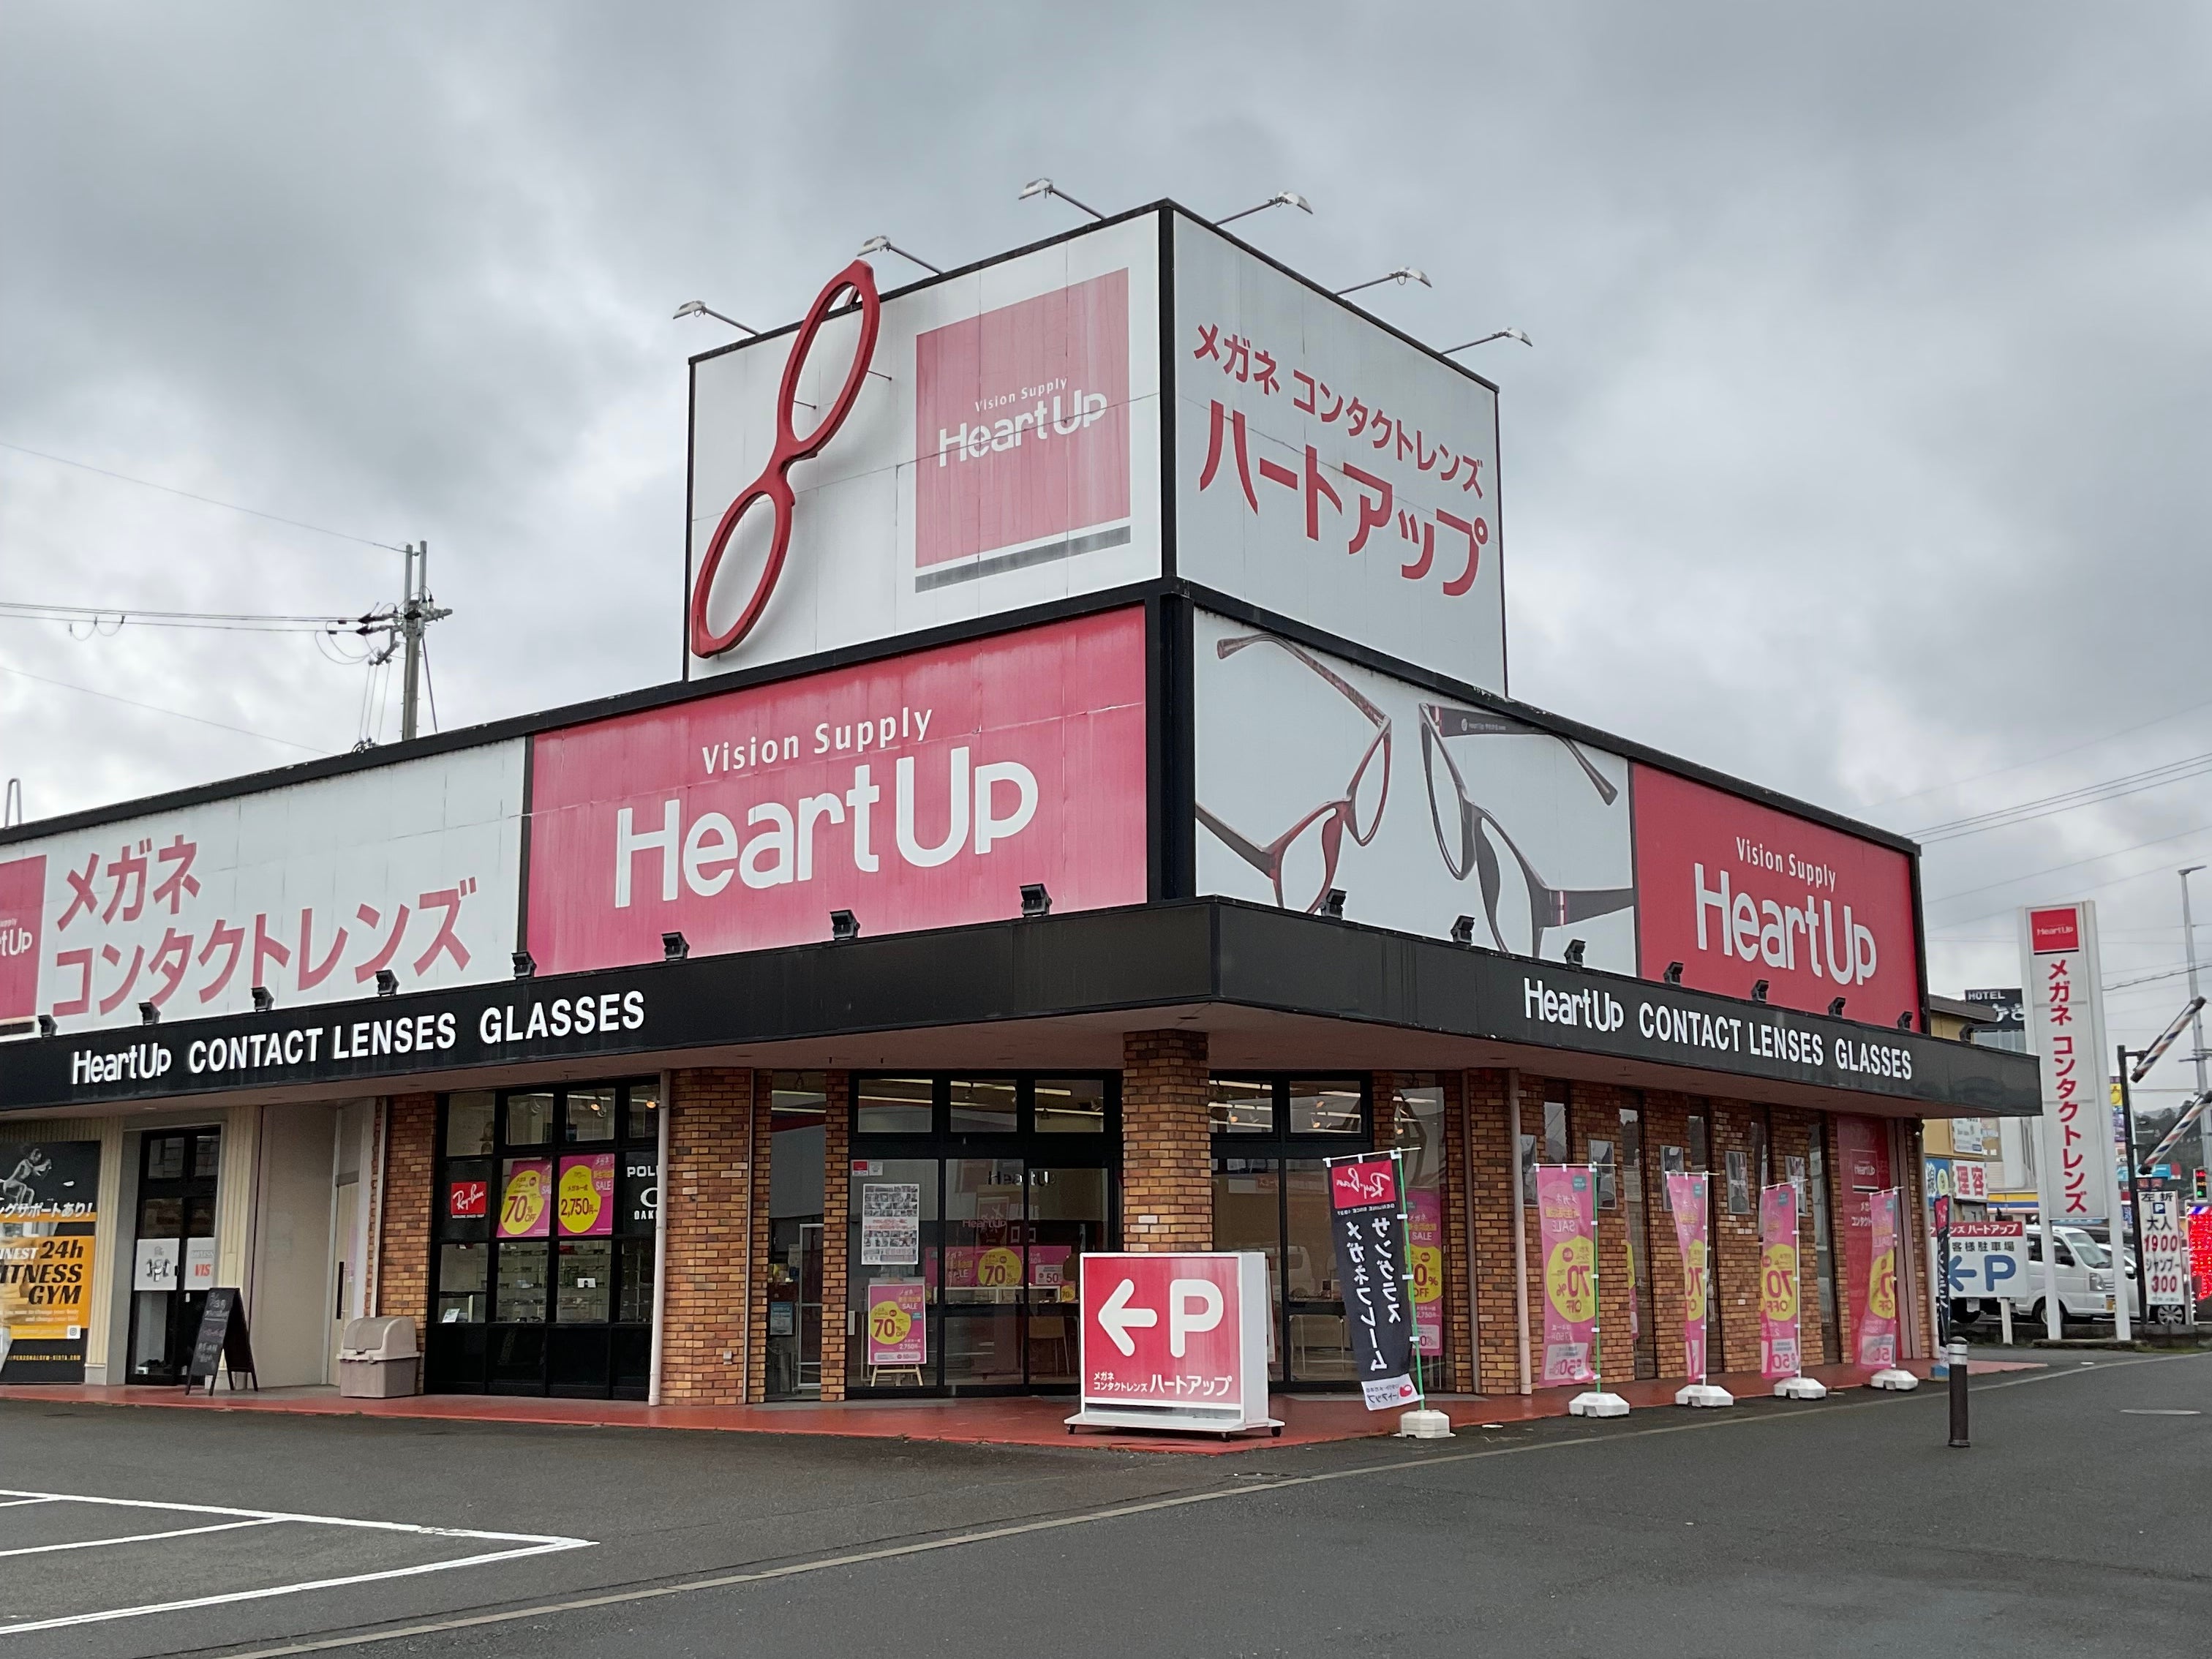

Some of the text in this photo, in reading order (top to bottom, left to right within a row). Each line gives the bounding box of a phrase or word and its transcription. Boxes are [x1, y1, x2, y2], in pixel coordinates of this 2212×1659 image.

[974, 377, 1069, 413] Vision Supply
[1194, 323, 1483, 499] メガネ コンタクトレンズ
[1200, 399, 1489, 597] ハートアップ
[702, 707, 933, 775] Vision Supply
[1736, 836, 1837, 893] Vision Supply
[56, 833, 202, 932] メガネ
[53, 876, 478, 1017] コンタクトレンズ
[1968, 991, 2006, 1001] HOTEL
[2048, 959, 2072, 1026] メガネ
[189, 1029, 320, 1075] CONTACT
[332, 1012, 457, 1061] LENSES
[478, 990, 645, 1045] GLASSES
[1639, 1002, 1742, 1053] CONTACT
[1748, 1021, 1824, 1066] LENSES
[1835, 1038, 1913, 1080] GLASSES
[2053, 1036, 2087, 1213] コンタクトレンズ
[595, 1181, 612, 1191] SALE
[634, 1211, 658, 1220] OAK
[2147, 1216, 2172, 1231] 大人
[1412, 1232, 1432, 1241] SALE
[1968, 1224, 2019, 1235] ハートアップ
[40, 1239, 84, 1259] 24h
[2144, 1234, 2178, 1252] 1900
[1984, 1254, 2017, 1292] P
[2146, 1258, 2180, 1271] シャンプー
[29, 1284, 83, 1305] GYM
[2151, 1275, 2177, 1293] 300
[1170, 1279, 1224, 1358] P
[1094, 1372, 1114, 1381] メガネ
[1094, 1381, 1148, 1392] コンタクトレンズ
[1150, 1374, 1233, 1396] ハートアップ
